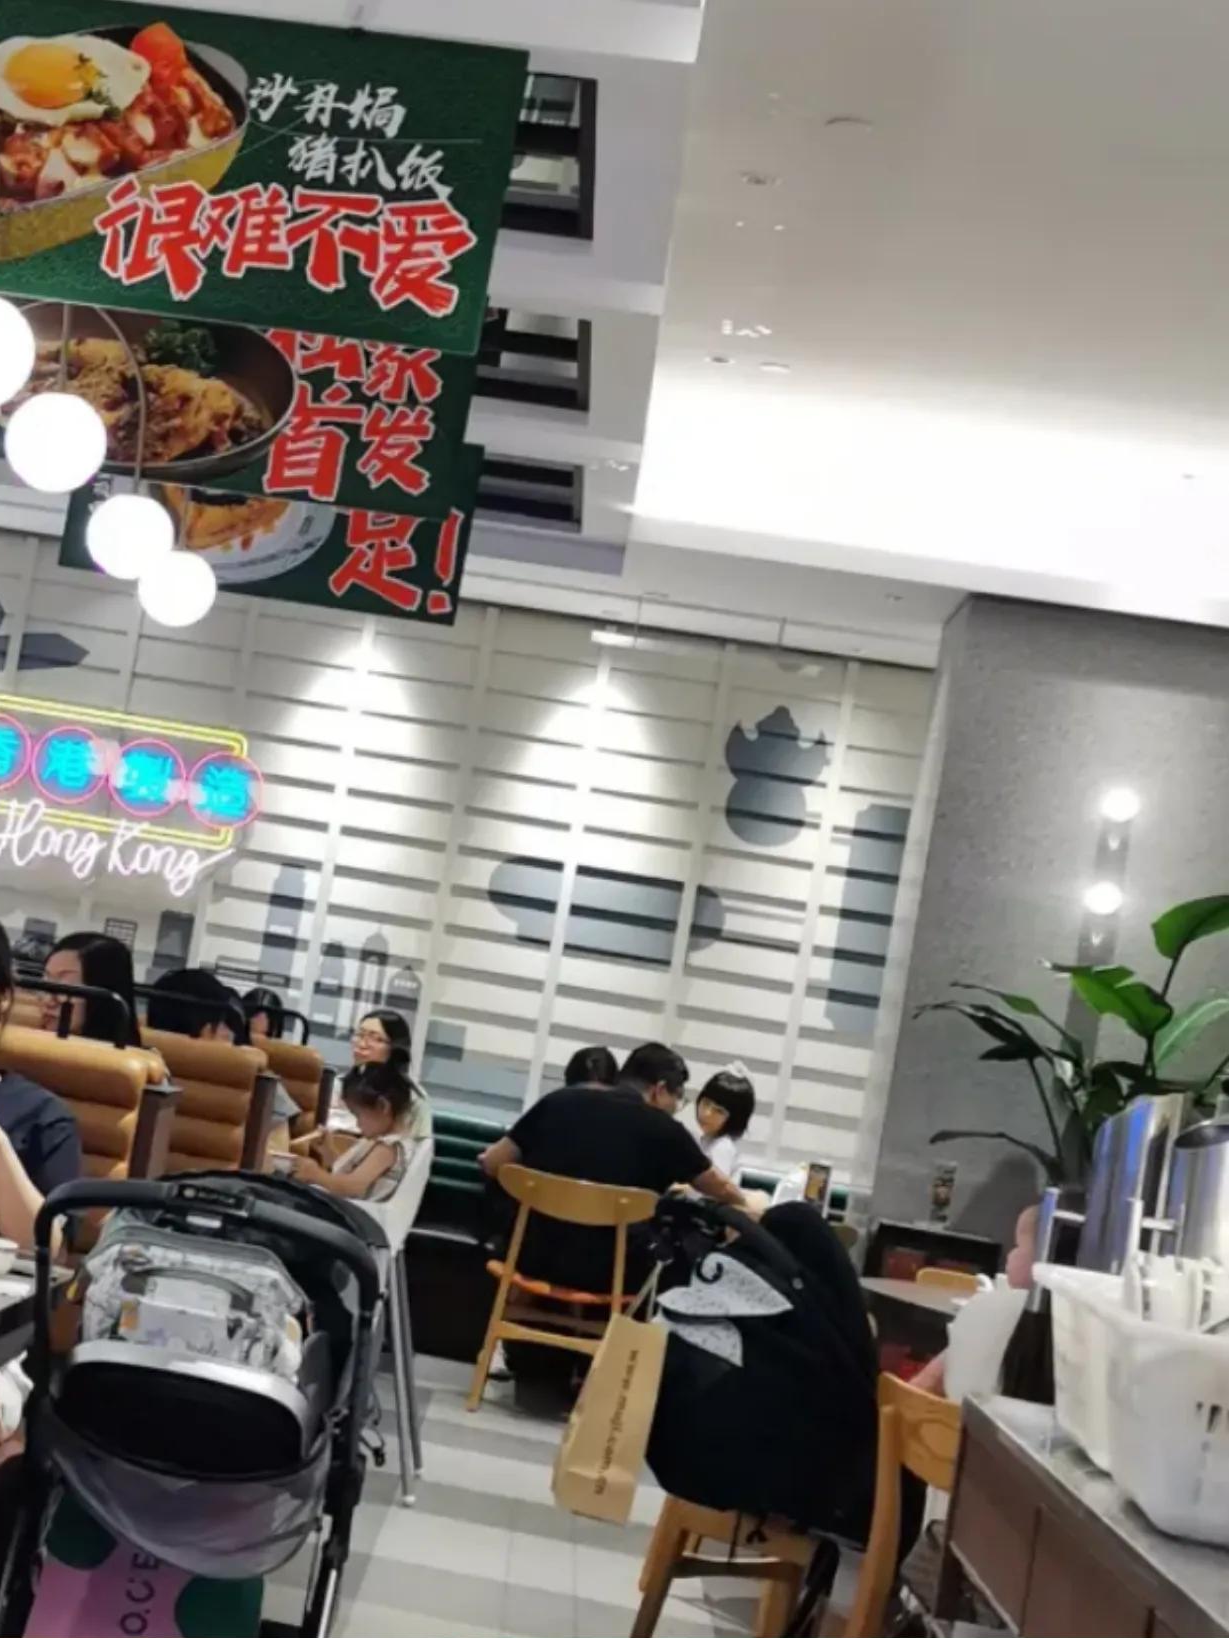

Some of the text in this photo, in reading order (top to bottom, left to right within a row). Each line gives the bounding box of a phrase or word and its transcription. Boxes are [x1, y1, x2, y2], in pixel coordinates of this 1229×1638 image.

[287, 132, 454, 202] 猪扒饭
[94, 178, 478, 318] 很难不爱
[261, 380, 436, 502] 首发
[108, 818, 236, 898] Kong
